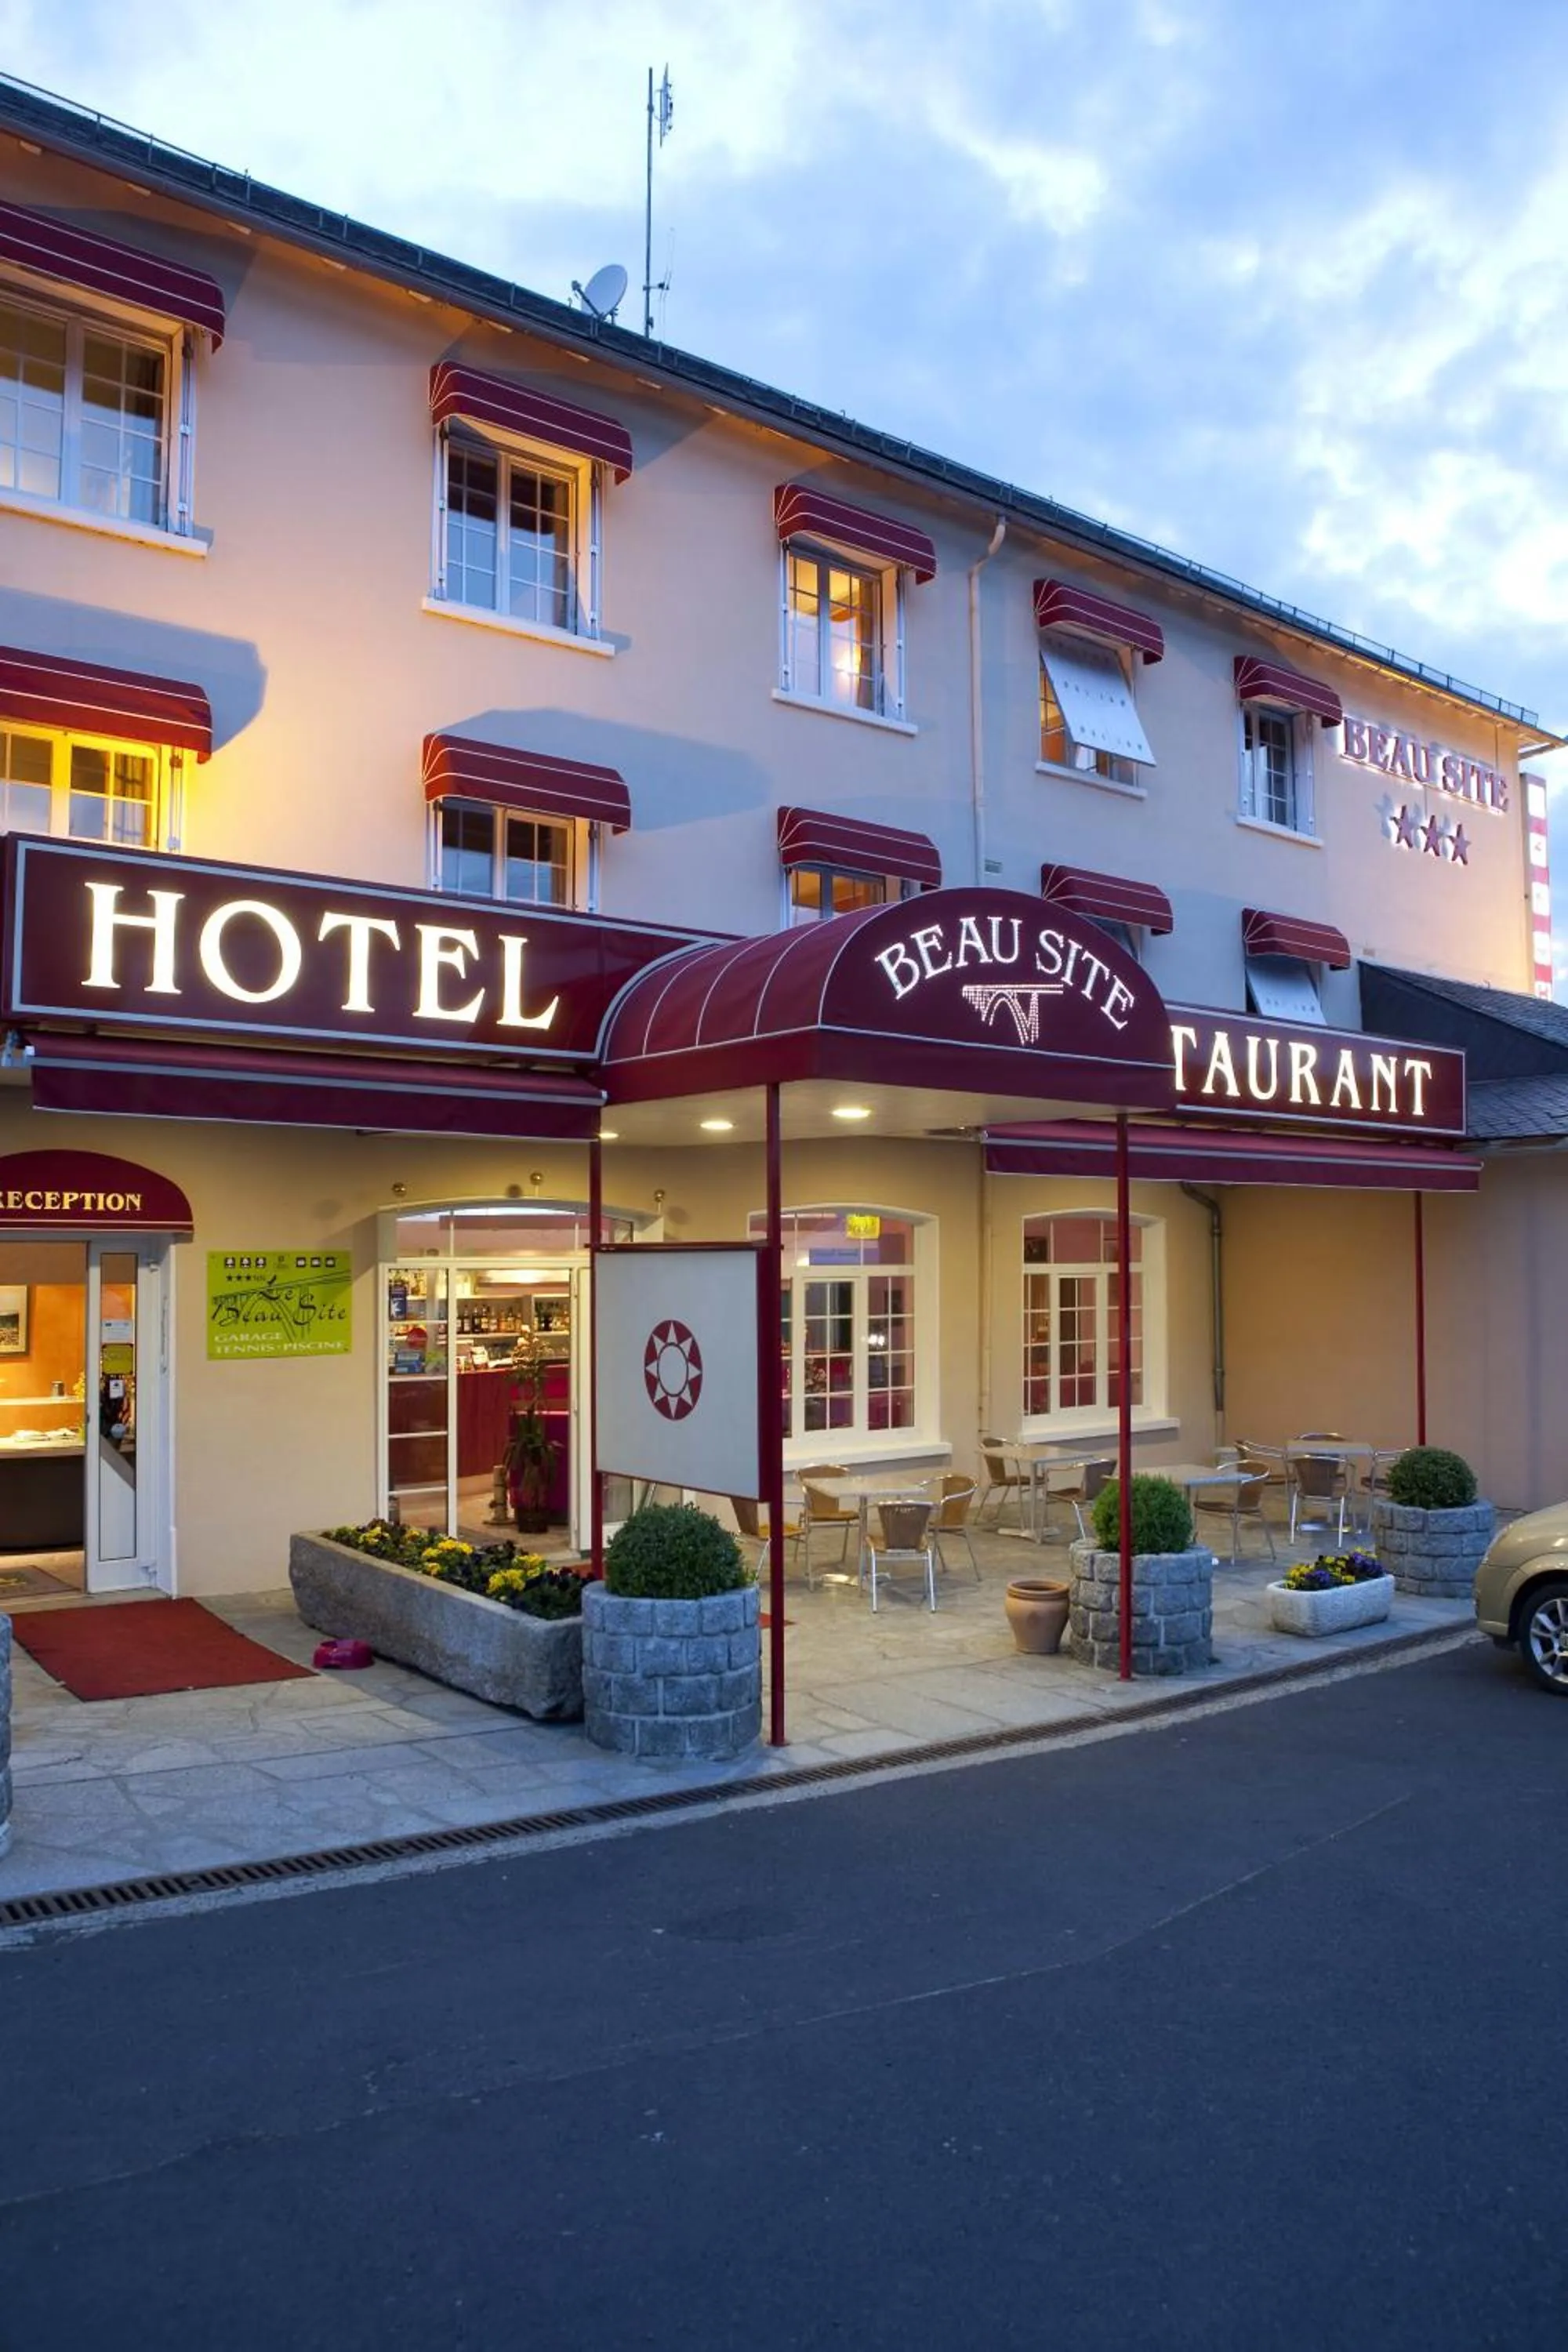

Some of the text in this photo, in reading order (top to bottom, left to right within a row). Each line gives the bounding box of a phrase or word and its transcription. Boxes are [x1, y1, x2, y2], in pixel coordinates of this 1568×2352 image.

[1343, 716, 1509, 813] BEAU SITE
[81, 881, 560, 1030] HOTEL
[874, 916, 1135, 1030] BEAU SITE
[1170, 1024, 1433, 1116] TAURANT
[0, 1190, 143, 1211] ECEPTION
[214, 1332, 284, 1343] GARAGE
[215, 1341, 346, 1355] TENNIS PISCINE
